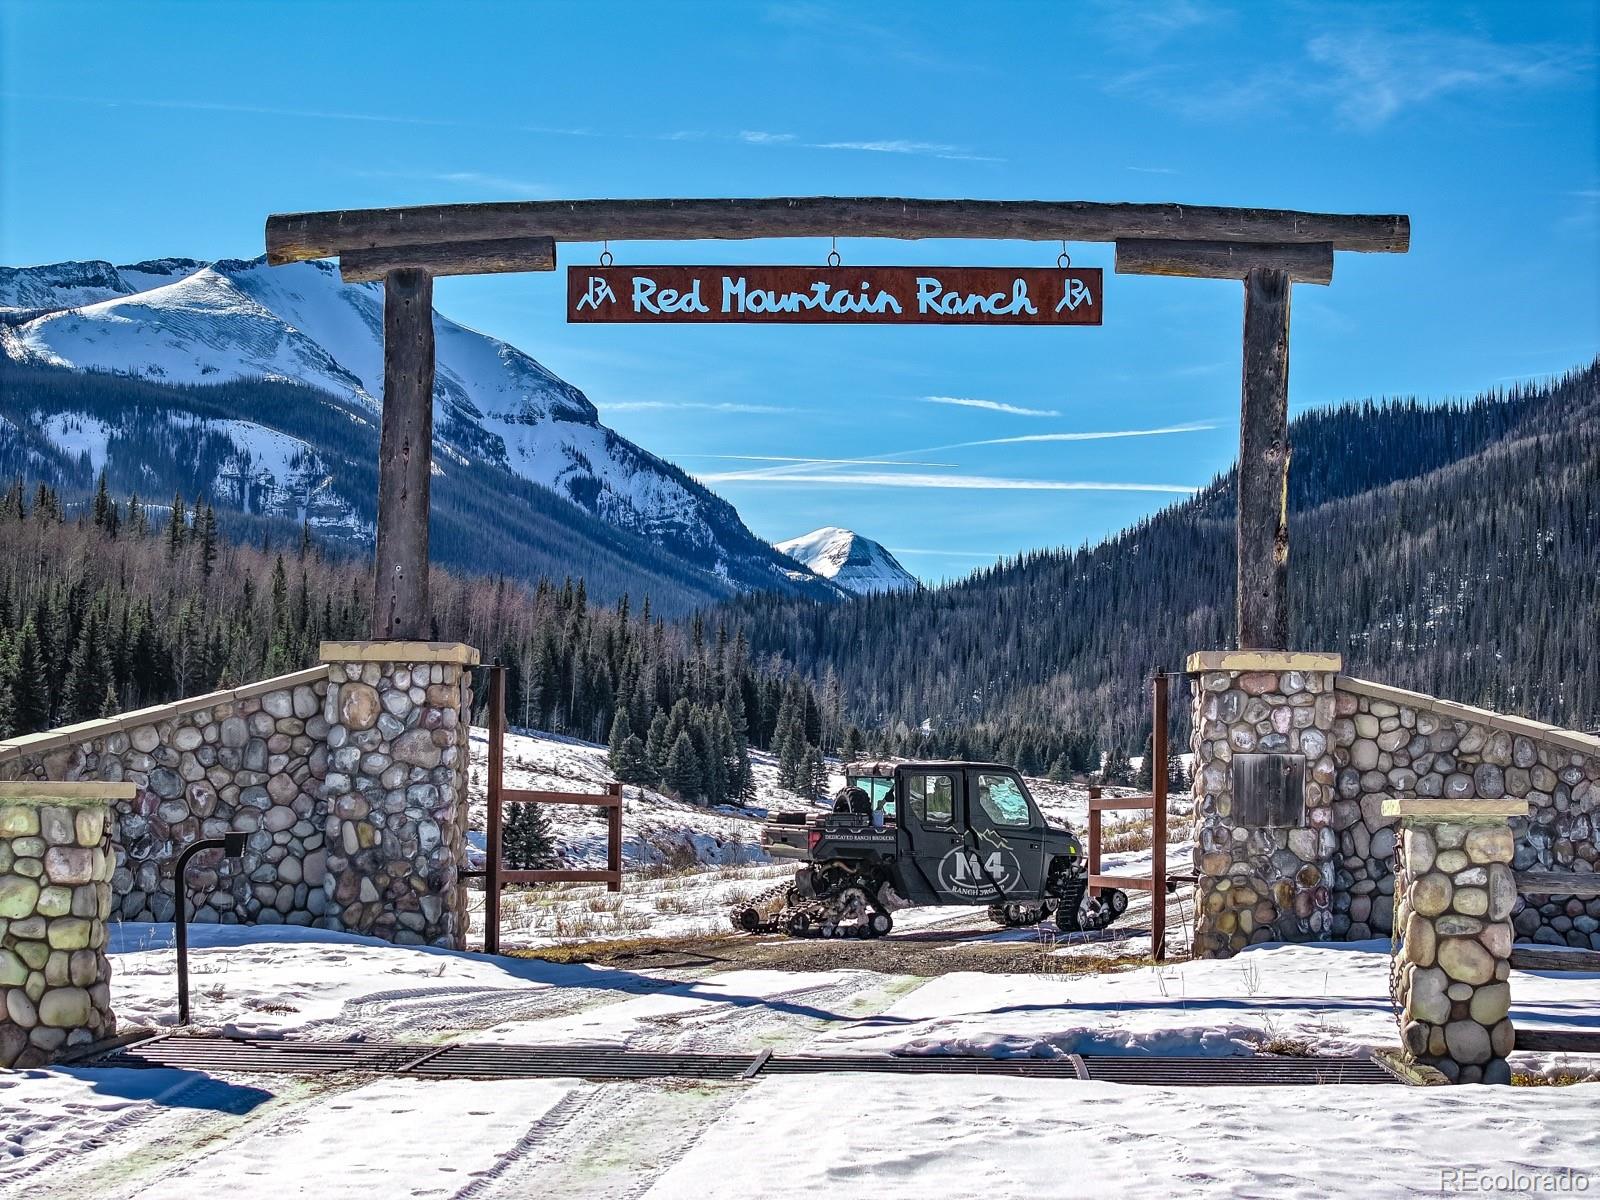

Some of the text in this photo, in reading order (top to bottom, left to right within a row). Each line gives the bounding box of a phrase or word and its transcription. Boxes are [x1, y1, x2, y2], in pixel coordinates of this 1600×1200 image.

[631, 276, 1038, 316] Red Mountain Ranch
[951, 885, 978, 896] RANCH
